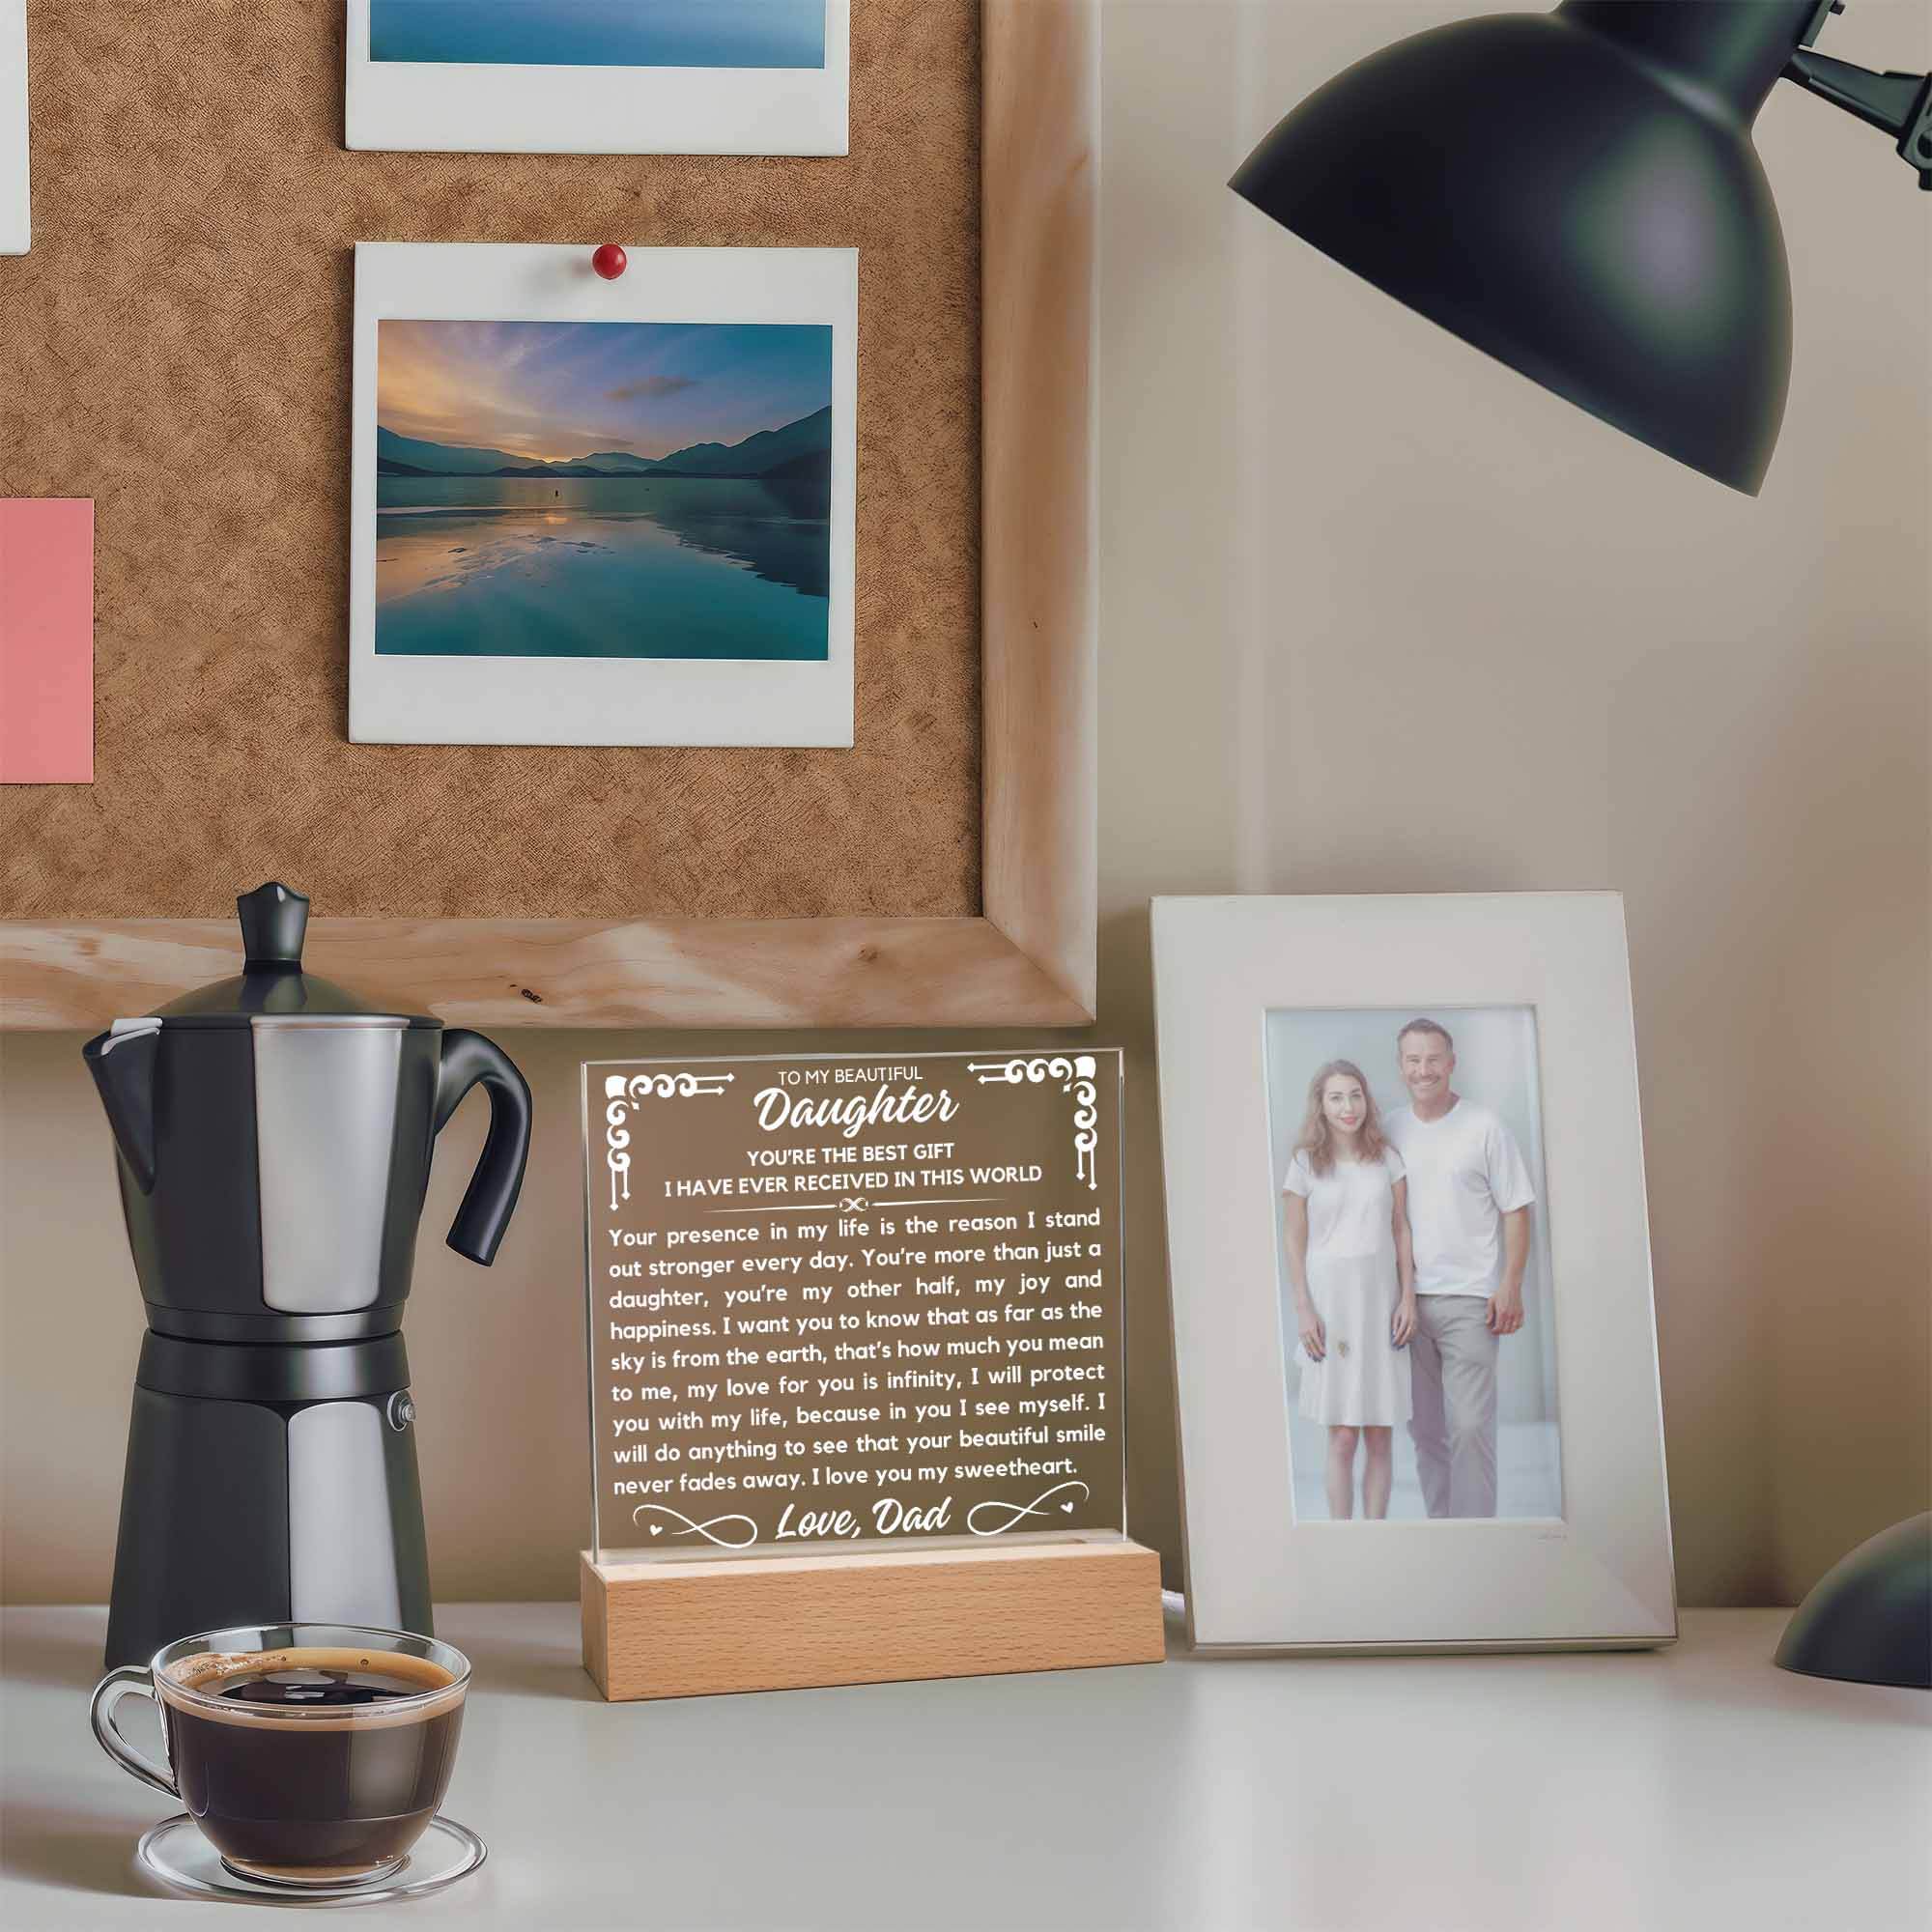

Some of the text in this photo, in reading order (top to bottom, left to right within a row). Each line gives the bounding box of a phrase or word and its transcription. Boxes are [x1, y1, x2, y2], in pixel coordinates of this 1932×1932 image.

[778, 1066, 923, 1086] TO MY BEAUTIFUL
[753, 1084, 959, 1138] Daughter
[747, 1143, 954, 1166] YOU'RE THE BEST GIFT
[665, 1166, 1042, 1197] I HAVE EVER RECEIVED IN THIS WORLD
[609, 1208, 1100, 1248] Your presence in my life is the reason I stand
[609, 1241, 1101, 1278] out stronger every day. You're more than just a
[609, 1268, 1101, 1311] daughter, you're my other half, my joy and
[611, 1300, 1102, 1343] happiness. I want you to know that as far as the
[611, 1336, 1103, 1375] sky is from the earth, that's how much you mean
[611, 1364, 1105, 1402] to me, my love for you is infinity, I will protect
[612, 1392, 1105, 1437] you with my life, because in you I see myself. I
[613, 1424, 1105, 1463] will do anything to see that your beautiful smile
[613, 1458, 1077, 1495] never fades away. I love you my sweetheart.
[775, 1496, 952, 1539] Love, Dad
